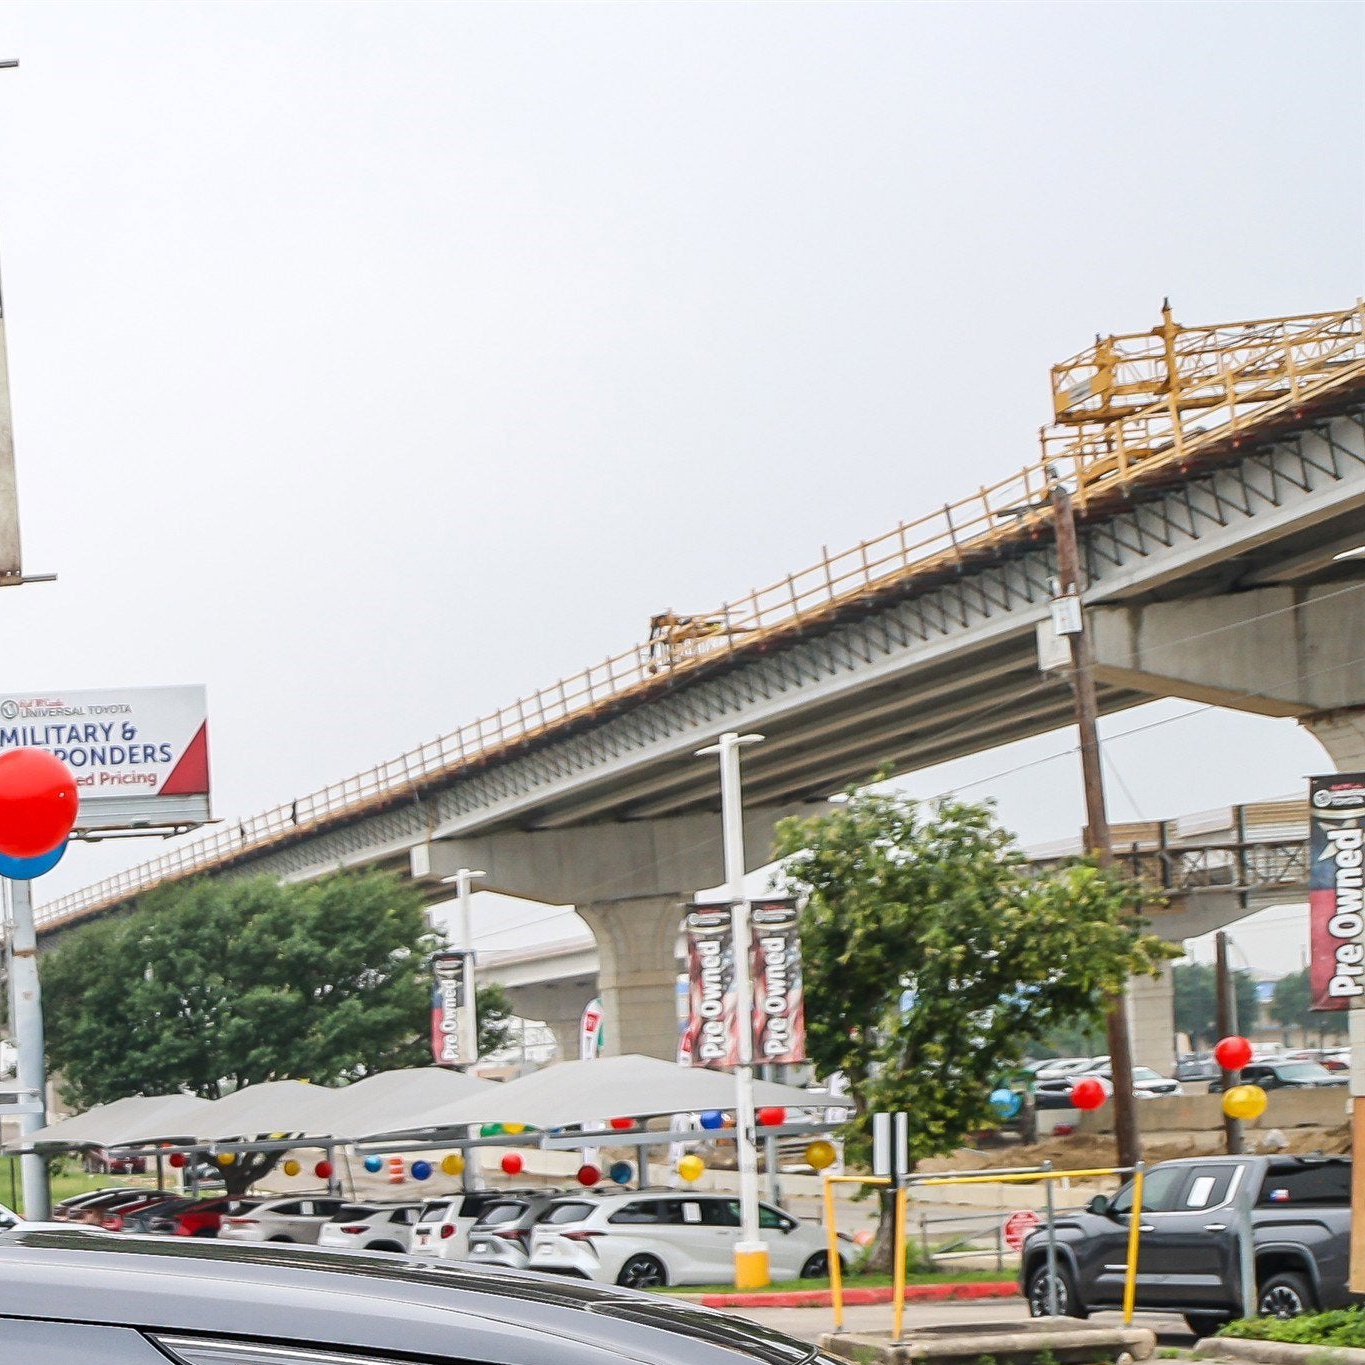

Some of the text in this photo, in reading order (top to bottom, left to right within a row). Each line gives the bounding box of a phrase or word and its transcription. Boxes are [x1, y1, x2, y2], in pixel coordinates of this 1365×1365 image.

[21, 704, 132, 718] UNIVERSAL TOYOTA
[0, 720, 137, 747] MILITARY &
[100, 771, 157, 786] Pricing
[1327, 828, 1364, 939] Owned
[696, 940, 723, 1018] Owned
[759, 937, 788, 1017] Owned
[1328, 943, 1364, 998] Pre
[440, 980, 457, 1034] Owned
[441, 1034, 459, 1060] Pre
[699, 1020, 726, 1060] Pre
[764, 1017, 789, 1056] Pre
